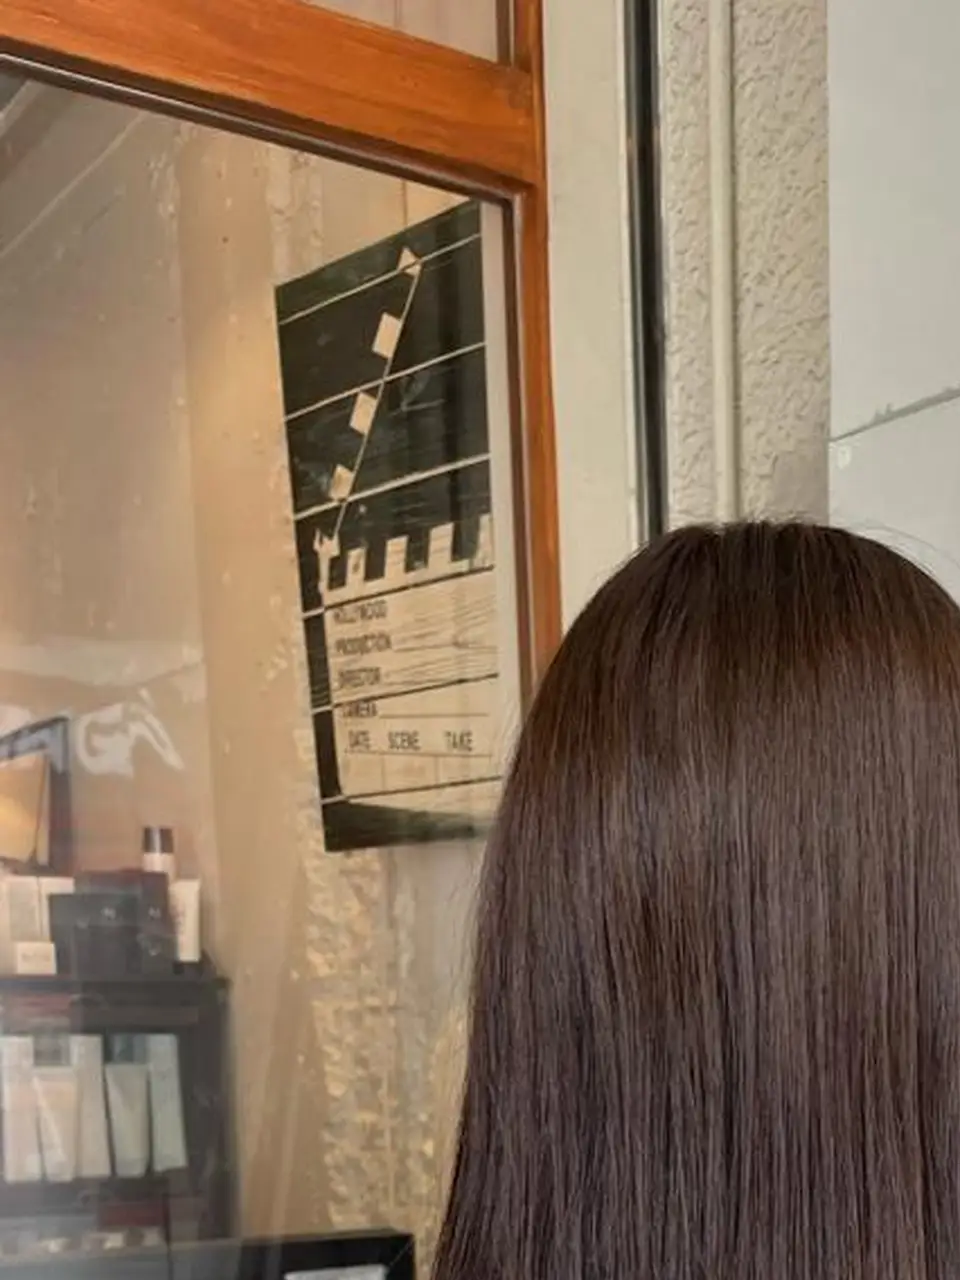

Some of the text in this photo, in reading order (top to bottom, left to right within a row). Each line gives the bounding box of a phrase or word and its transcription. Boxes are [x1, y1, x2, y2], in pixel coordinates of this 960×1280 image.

[335, 632, 391, 655] PRODUCTION
[348, 731, 472, 751] DATE SCENE TAKE
